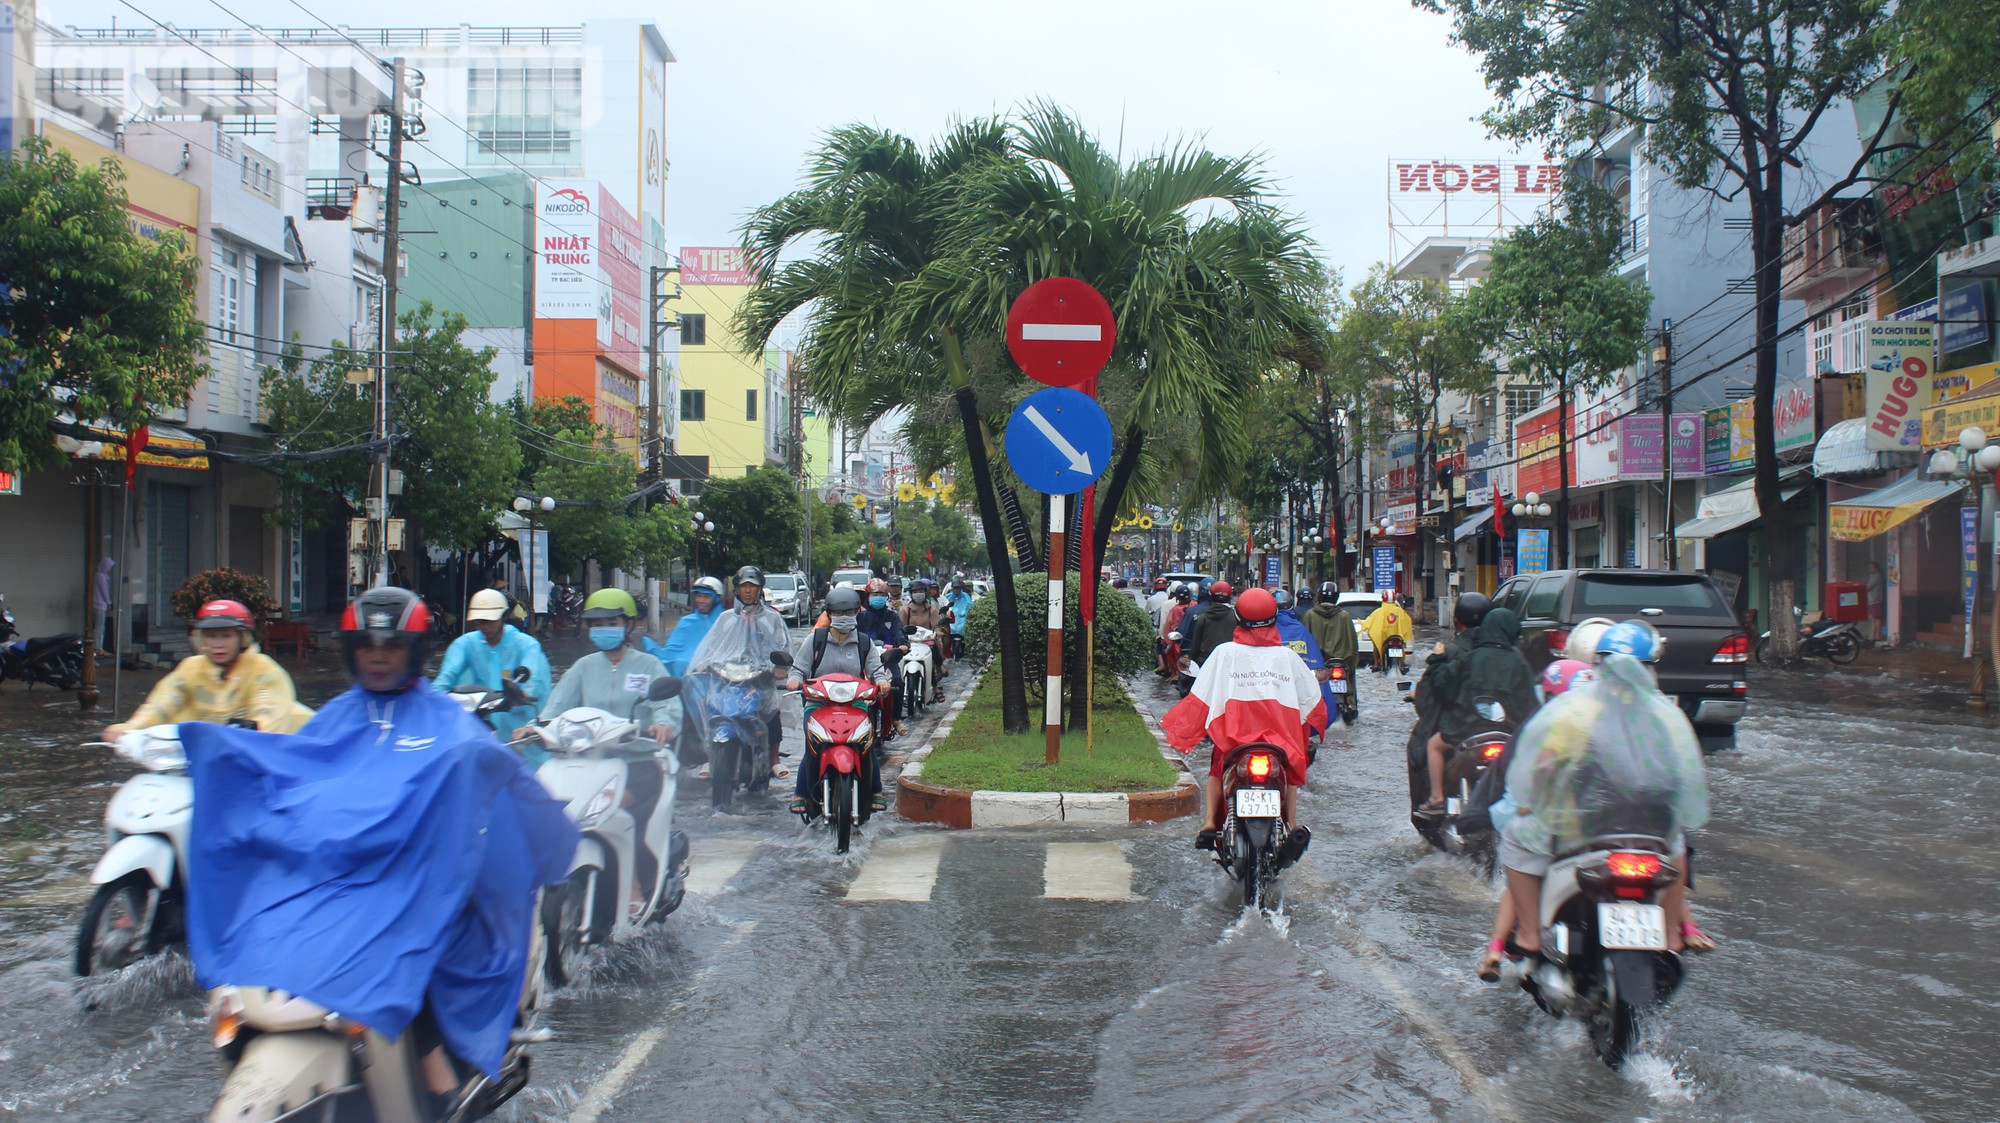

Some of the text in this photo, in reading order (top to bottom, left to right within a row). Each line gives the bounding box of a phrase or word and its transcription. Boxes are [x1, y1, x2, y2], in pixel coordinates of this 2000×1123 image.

[545, 203, 584, 212] NIKODO
[544, 234, 590, 253] NHẬT
[545, 253, 590, 265] TRUNG
[1871, 356, 1928, 439] HUGO
[1240, 803, 1278, 816] 437.15
